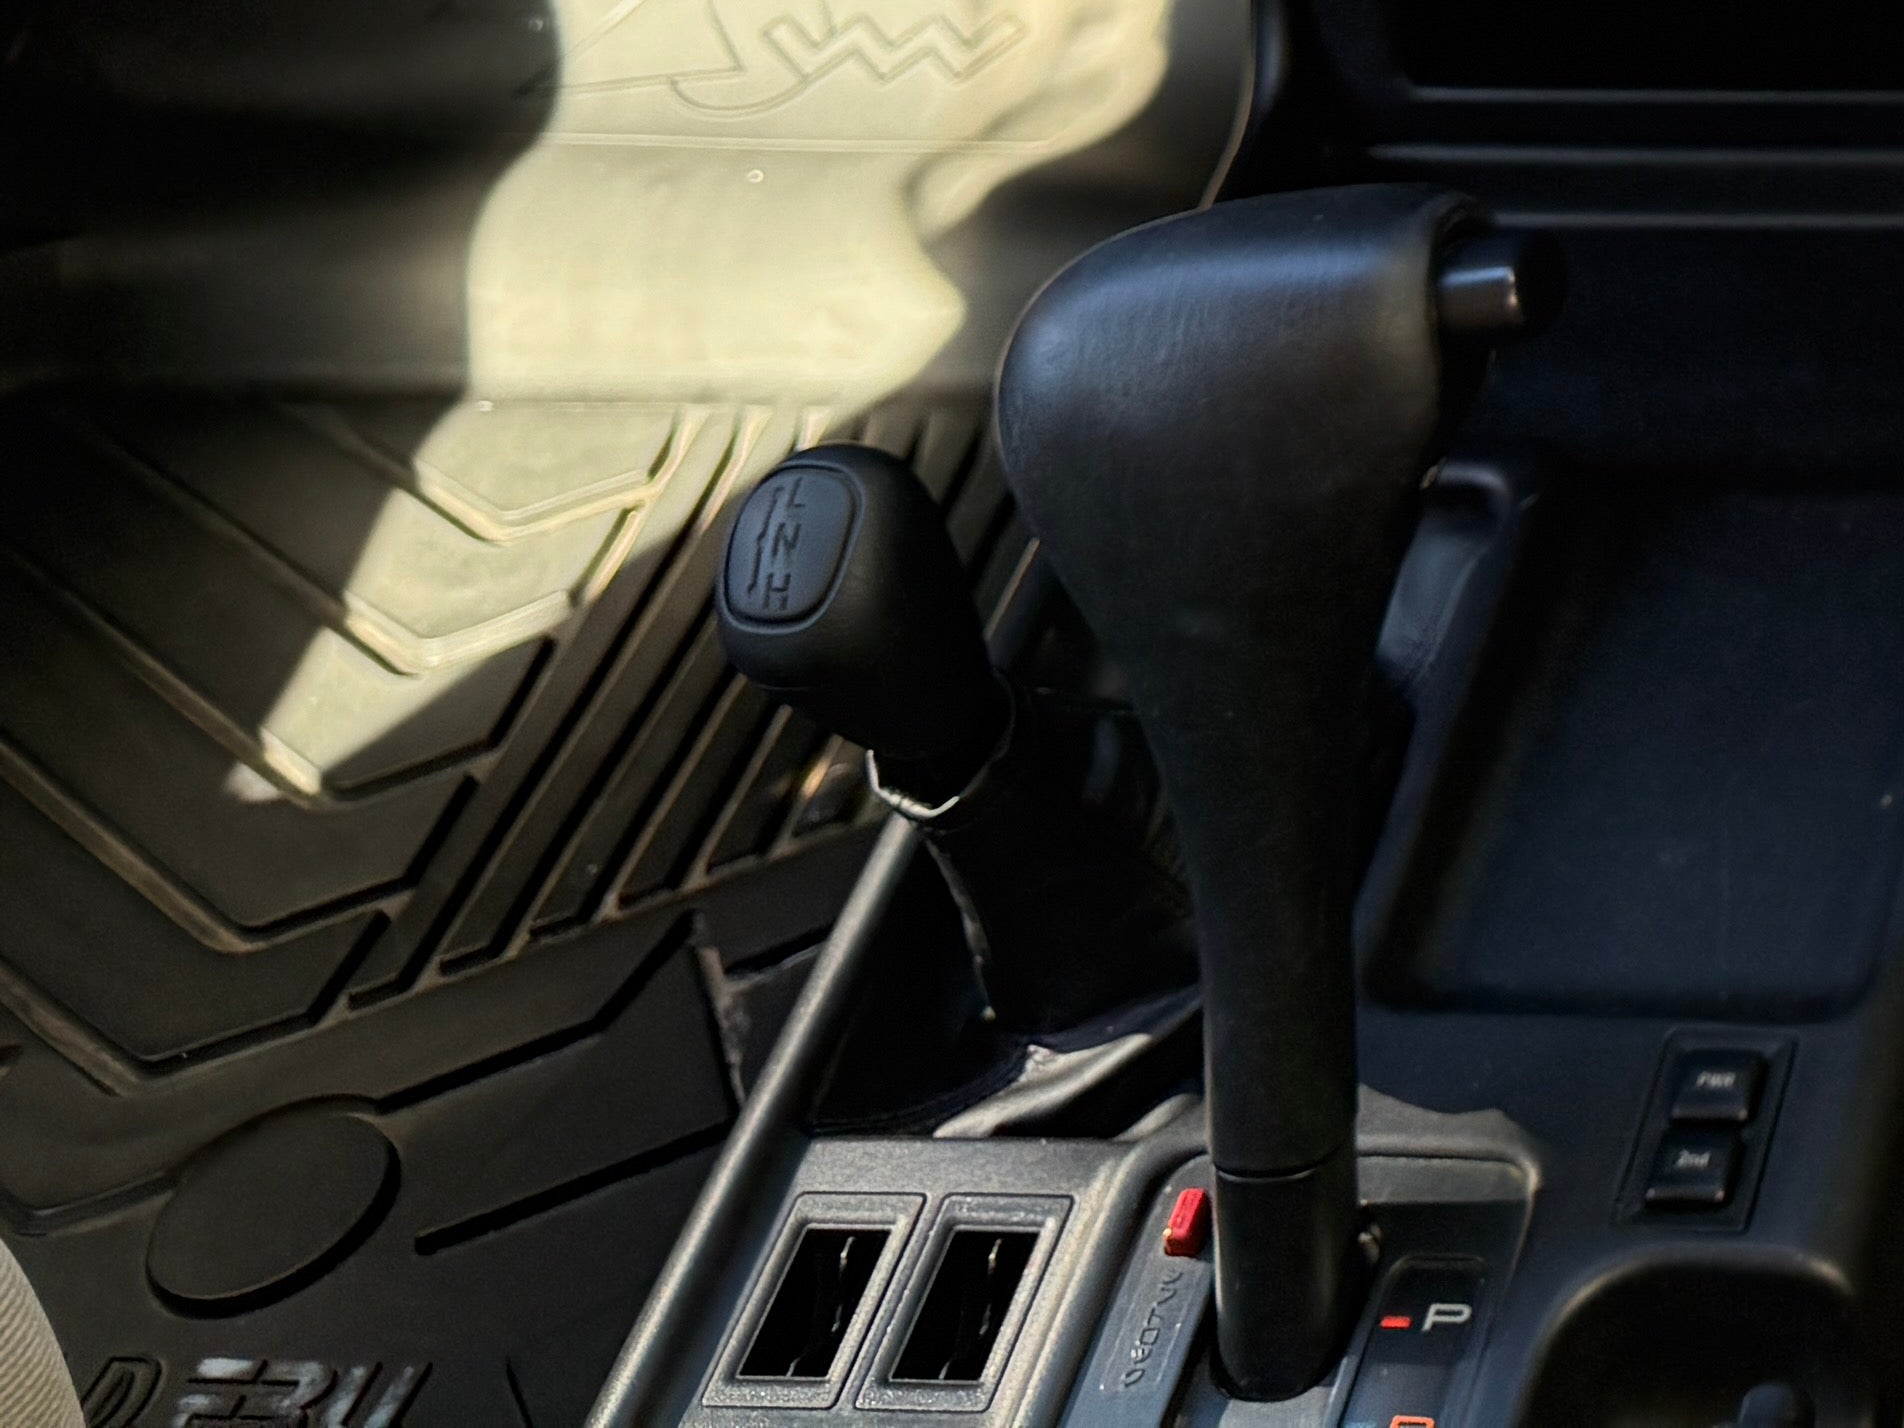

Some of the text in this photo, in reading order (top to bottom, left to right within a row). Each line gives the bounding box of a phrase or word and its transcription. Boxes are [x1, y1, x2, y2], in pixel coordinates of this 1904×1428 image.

[771, 521, 802, 559] N
[762, 571, 792, 610] H
[1422, 1302, 1473, 1332] P
